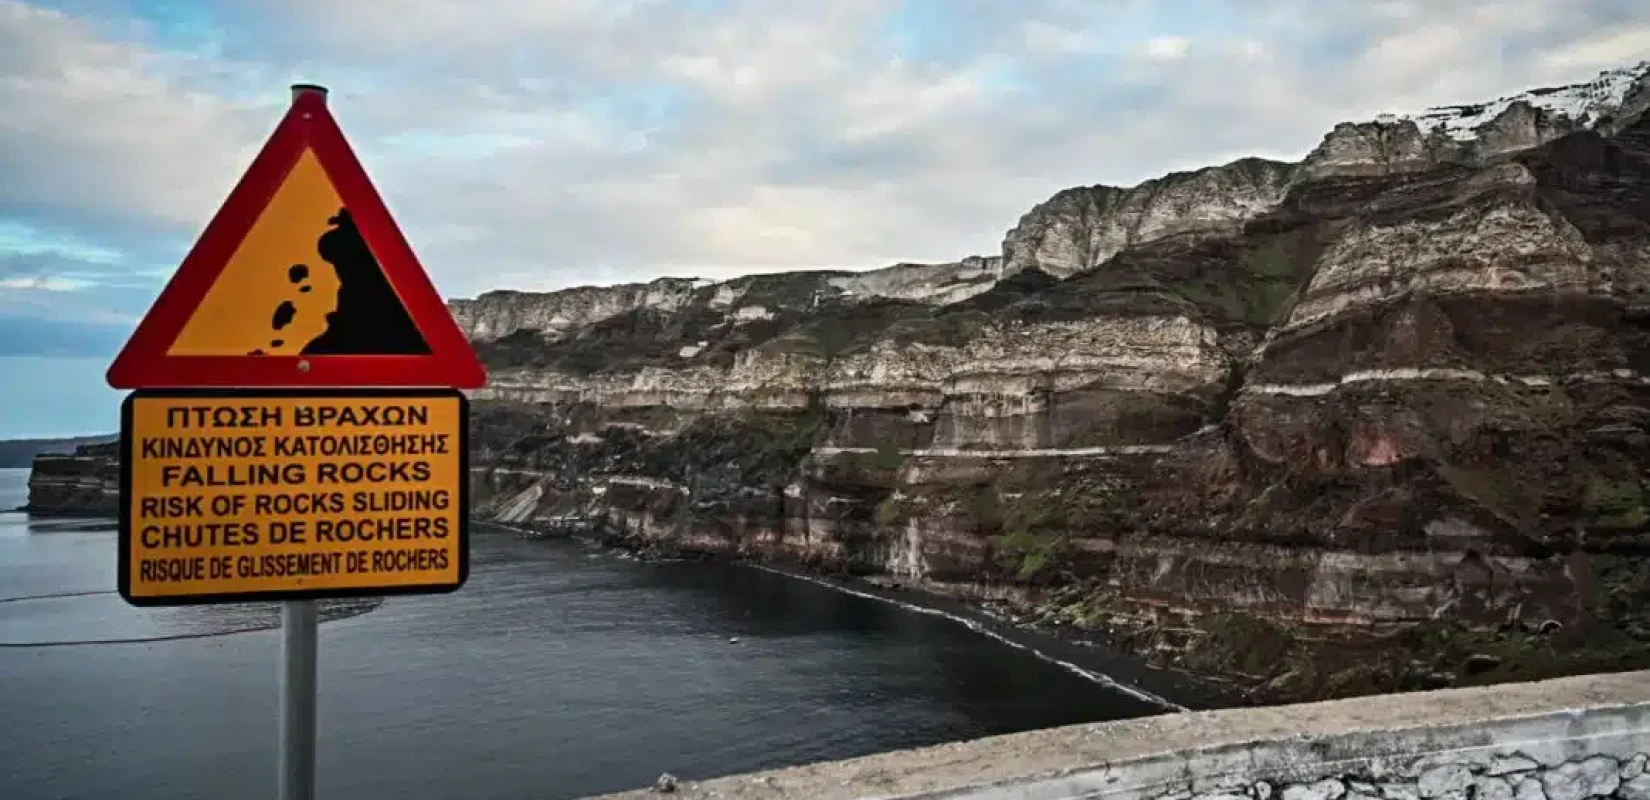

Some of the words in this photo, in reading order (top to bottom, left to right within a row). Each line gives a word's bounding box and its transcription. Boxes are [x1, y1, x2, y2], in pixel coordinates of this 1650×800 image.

[167, 406, 282, 428] ΠΤΩΣΗ
[295, 406, 427, 426] ΒΡΑΧΩΝ
[142, 437, 266, 459] ΚΙΝΔΥΝΟΣ
[275, 434, 448, 456] ΚΑΤΟΛΙΣΘΗΣΗΣ
[162, 464, 305, 487] FALLING
[317, 462, 430, 483] ROCKS
[140, 496, 204, 518] RISK
[211, 495, 246, 517] OF
[255, 493, 344, 515] ROCKS
[353, 490, 448, 512] SLIDING
[140, 523, 260, 549] CHUTES
[269, 522, 306, 544] DE
[316, 517, 448, 542] ROCHERS
[140, 557, 205, 583] RISQUE
[209, 556, 232, 580] DE
[236, 553, 342, 579] GLISSEMENT
[346, 551, 368, 573] DE
[372, 548, 448, 572] ROCHERS
